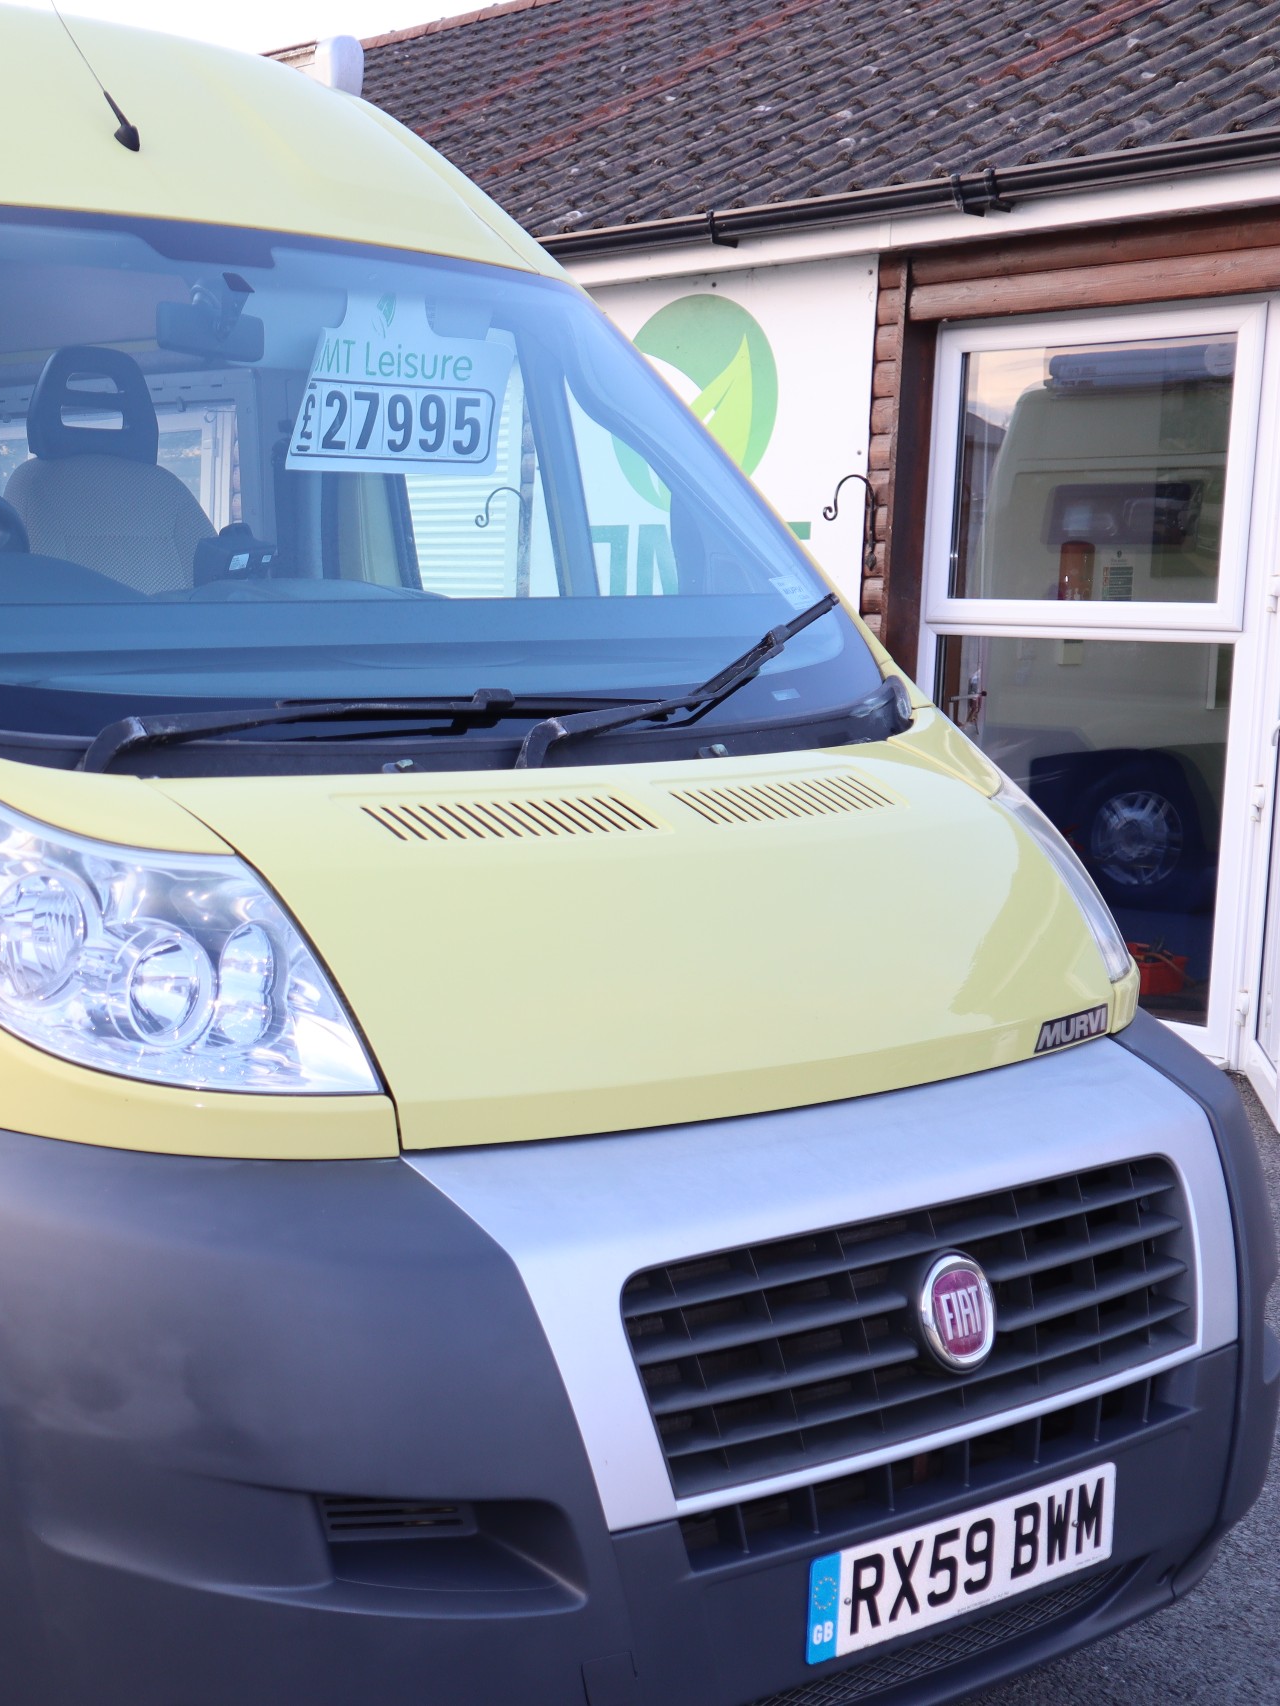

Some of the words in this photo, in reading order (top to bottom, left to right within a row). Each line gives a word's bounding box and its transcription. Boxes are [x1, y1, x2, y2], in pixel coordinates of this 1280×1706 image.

[365, 341, 473, 382] Leisure
[1036, 1007, 1107, 1051] MURVI
[940, 1284, 982, 1341] FIAT
[849, 1517, 996, 1637] RX59
[1010, 1476, 1106, 1581] BWM
[812, 1621, 834, 1645] GB
